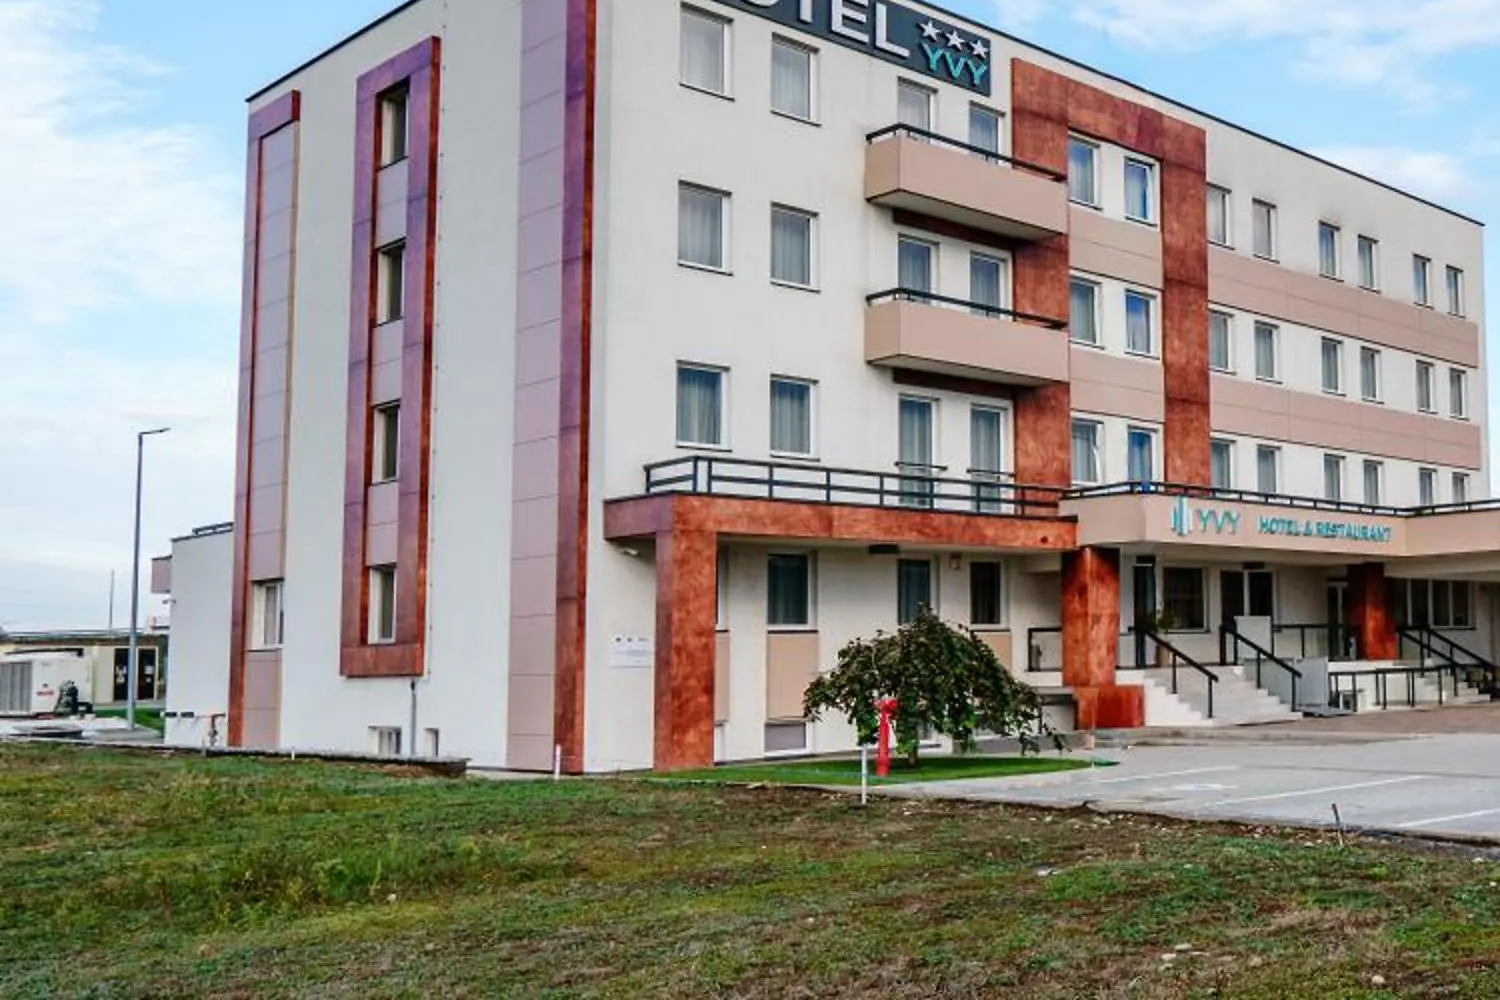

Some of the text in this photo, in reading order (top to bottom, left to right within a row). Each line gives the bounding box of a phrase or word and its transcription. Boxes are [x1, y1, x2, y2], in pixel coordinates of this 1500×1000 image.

[922, 41, 988, 86] YVY
[1196, 508, 1242, 534] YVY
[1258, 515, 1300, 536] HOTEL
[1315, 521, 1391, 543] RESTAURANT
